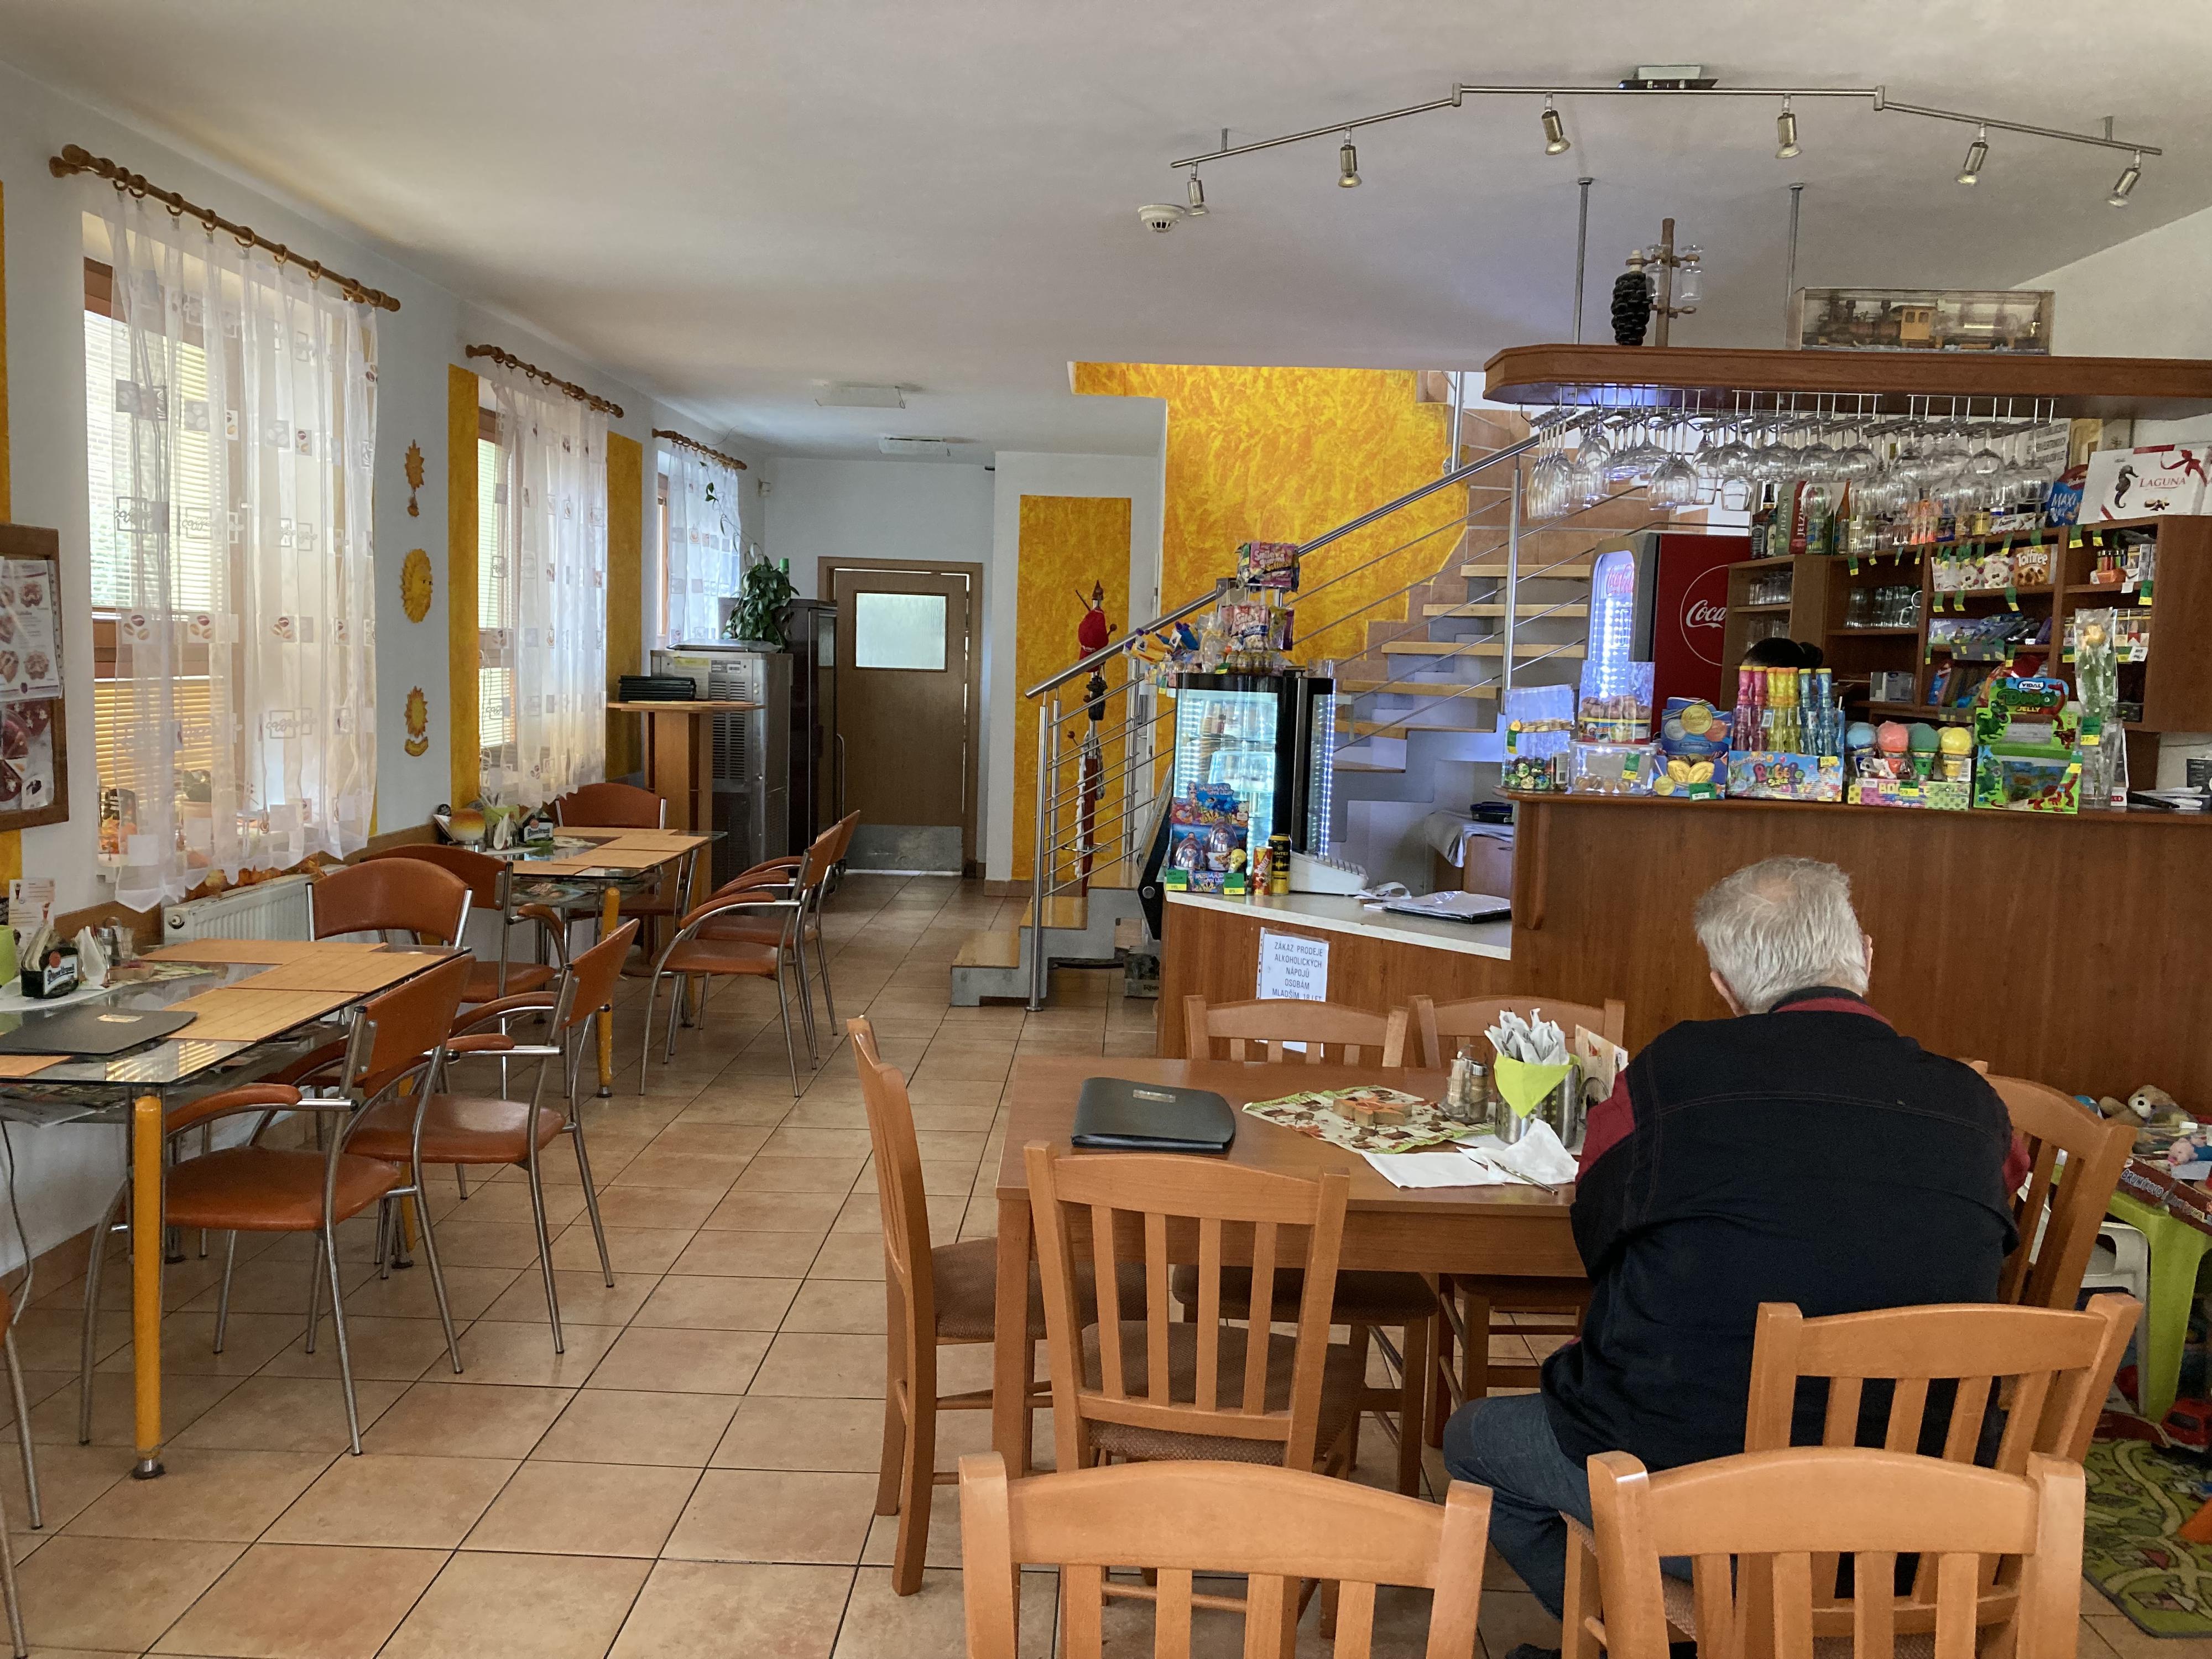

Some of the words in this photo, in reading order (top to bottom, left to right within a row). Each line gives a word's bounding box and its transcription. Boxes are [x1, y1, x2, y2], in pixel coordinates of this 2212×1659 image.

[2139, 477, 2186, 488] LAGUNA
[2051, 493, 2077, 508] MAXI
[1686, 599, 1727, 628] Coca
[1275, 942, 1293, 952] ZÁKAZ
[1297, 946, 1323, 956] PRODEJE
[1275, 954, 1322, 968] ALKOHOLICKÝCH
[1286, 967, 1310, 978] NÁPOJŮ
[1285, 979, 1309, 989] OSOBÁM
[1273, 988, 1299, 999] MLADŠÍM
